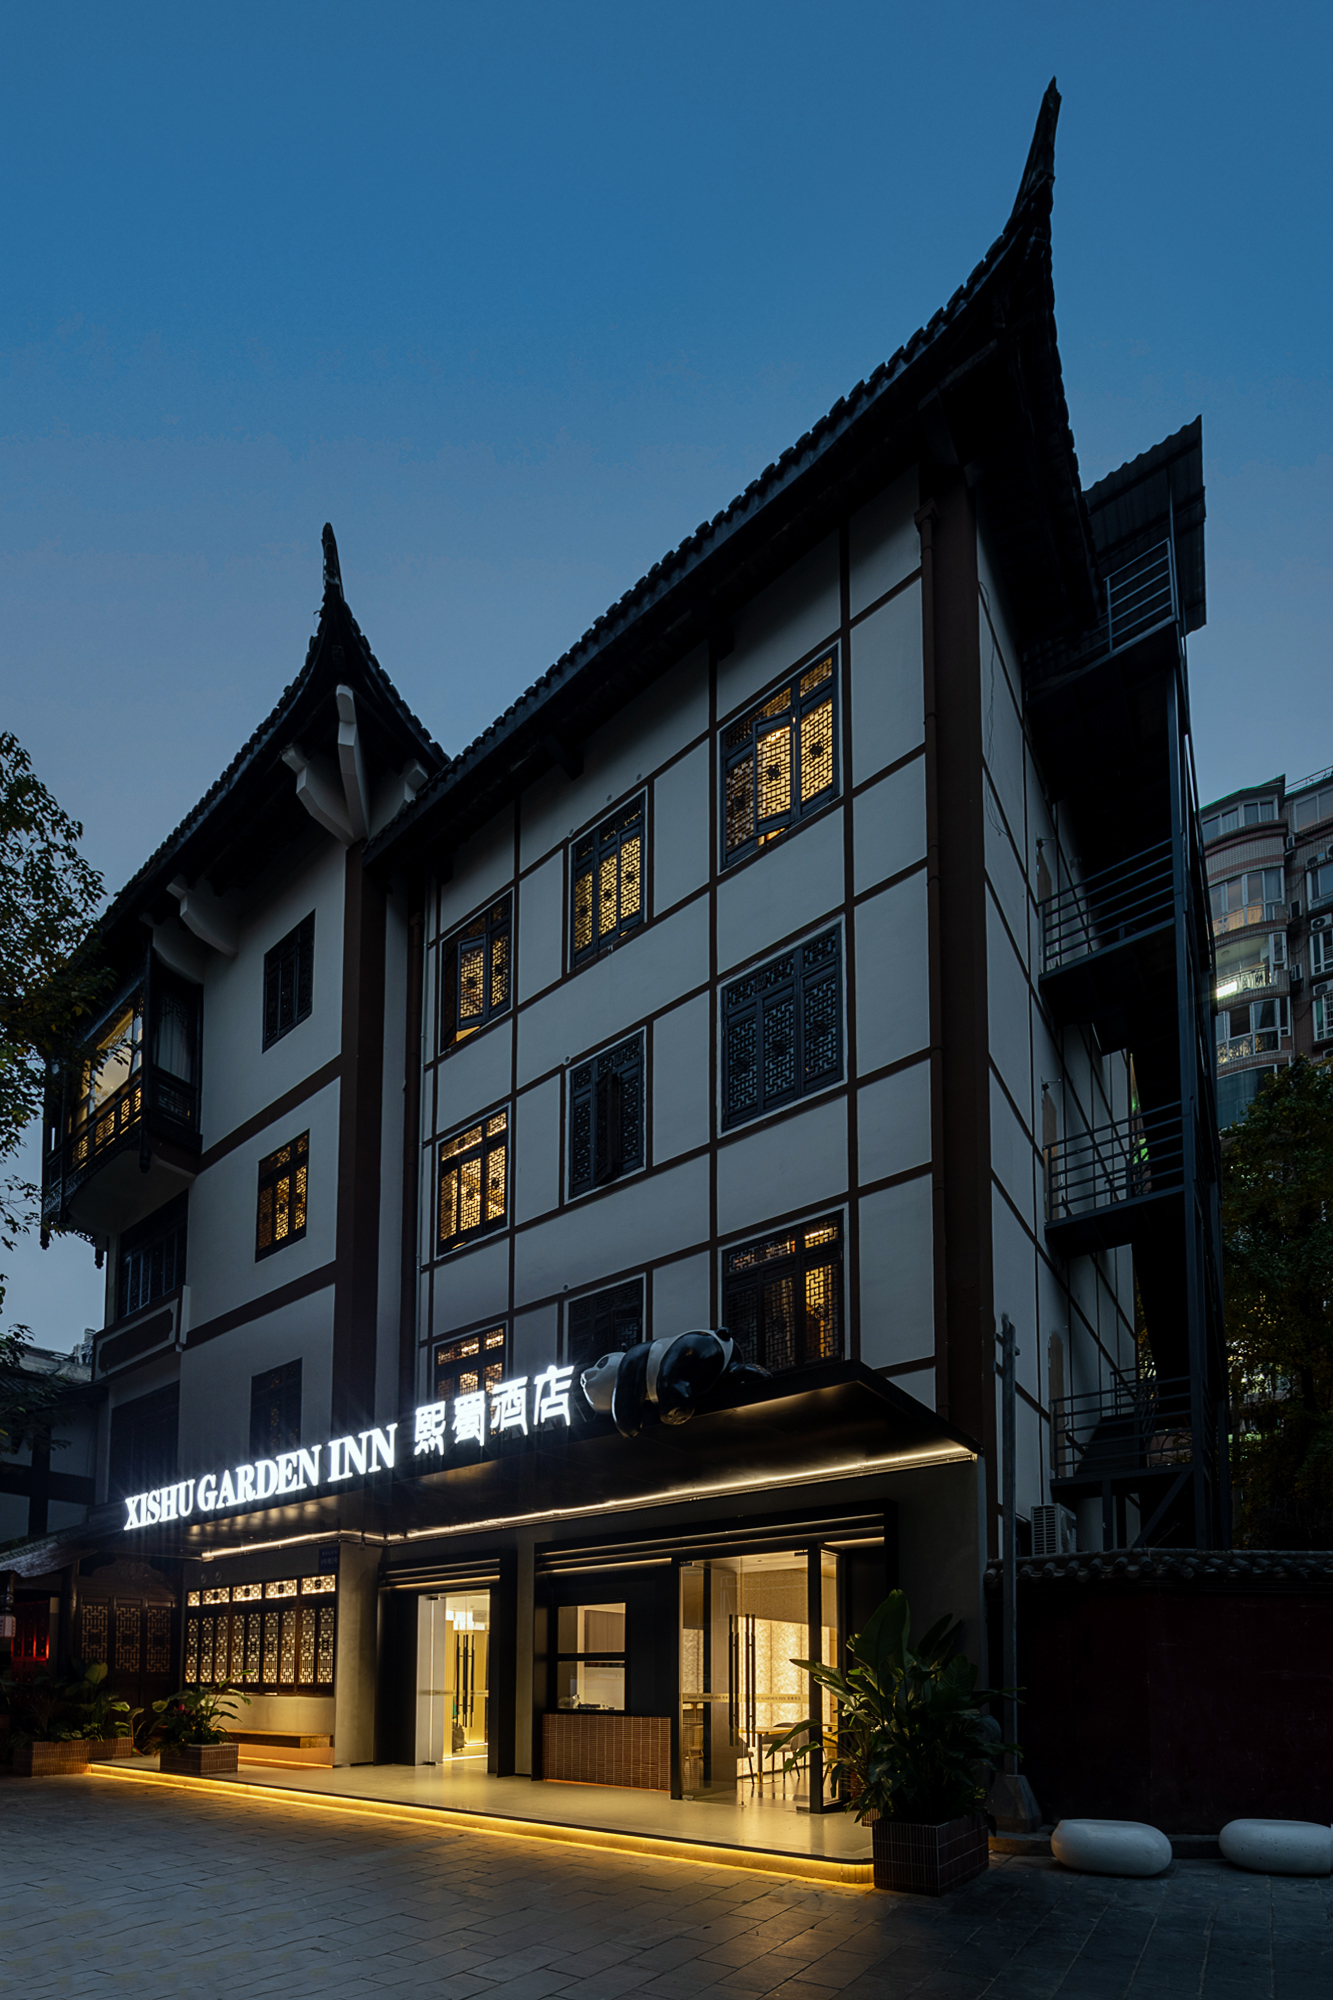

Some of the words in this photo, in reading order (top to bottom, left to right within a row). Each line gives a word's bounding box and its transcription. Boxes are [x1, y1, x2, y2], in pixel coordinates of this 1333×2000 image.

[414, 1364, 575, 1456] 熙蜀酒店
[123, 1479, 196, 1531] XISHU
[197, 1444, 322, 1512] GARDEN
[327, 1422, 399, 1483] INN
